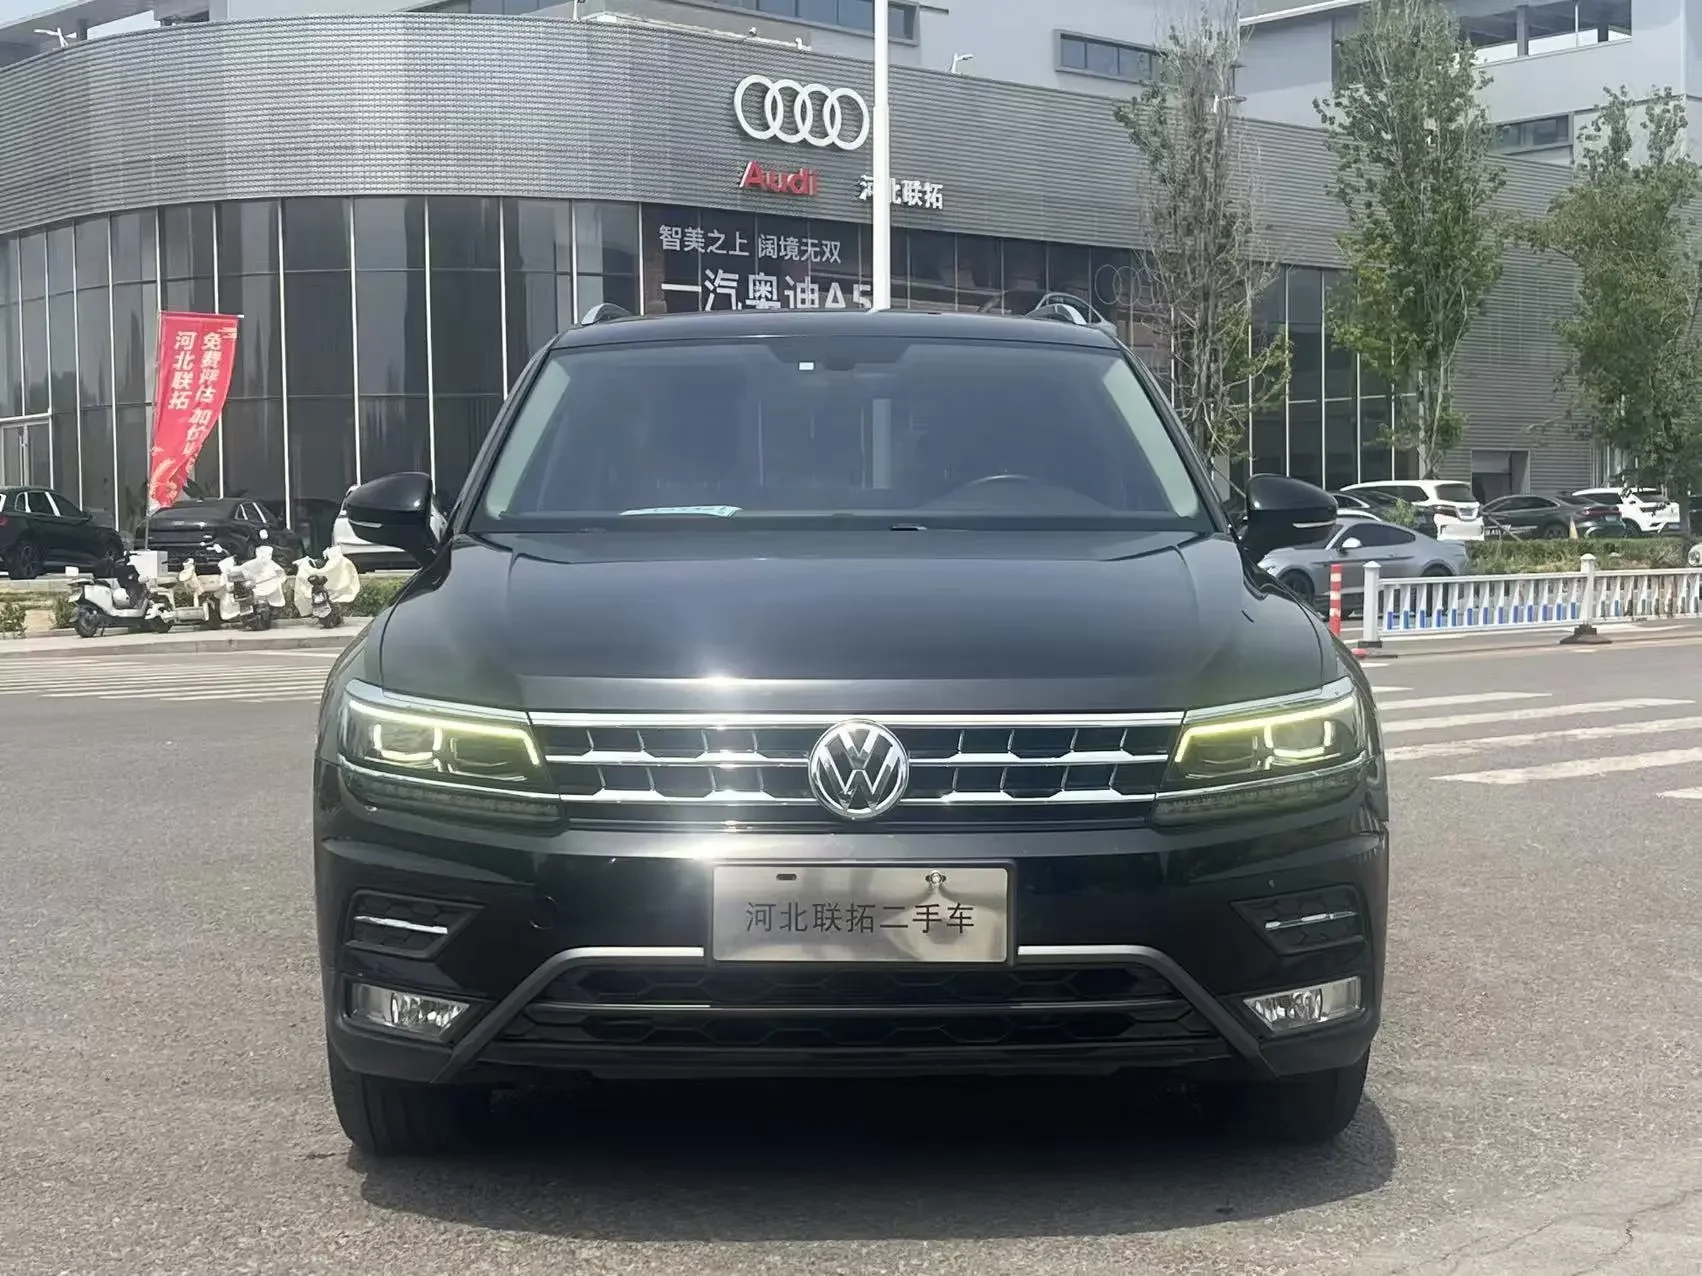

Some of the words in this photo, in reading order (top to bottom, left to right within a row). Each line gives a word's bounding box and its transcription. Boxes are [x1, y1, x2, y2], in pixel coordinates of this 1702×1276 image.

[739, 160, 818, 196] Audi
[659, 225, 750, 256] 智美之上
[758, 234, 842, 264] 阔境无双
[167, 331, 198, 410] 河北联拓
[746, 901, 975, 934] 河北联拓二手车
